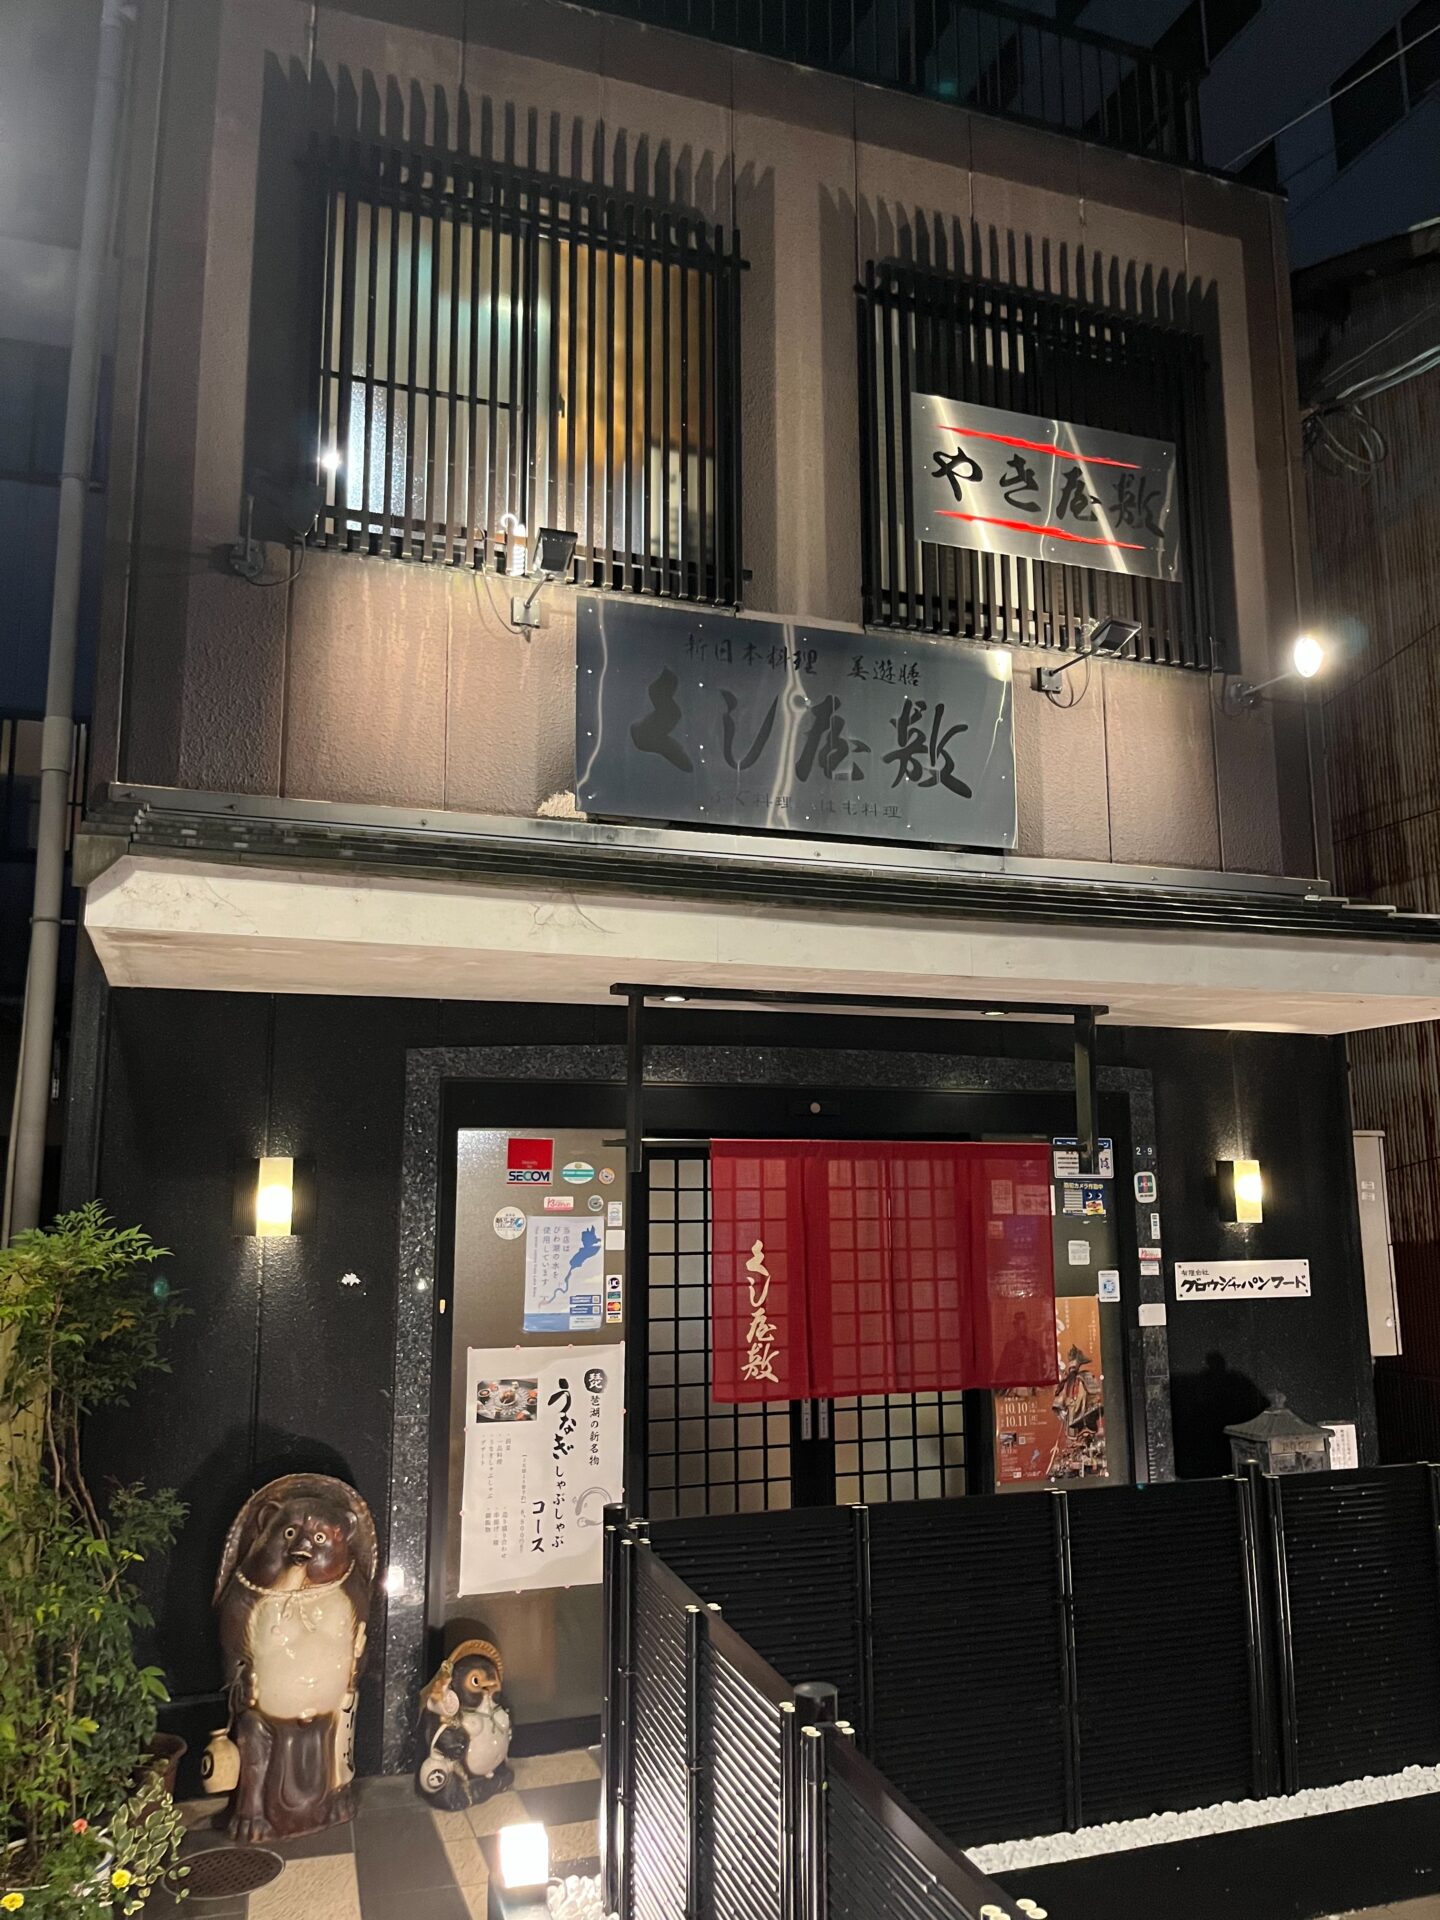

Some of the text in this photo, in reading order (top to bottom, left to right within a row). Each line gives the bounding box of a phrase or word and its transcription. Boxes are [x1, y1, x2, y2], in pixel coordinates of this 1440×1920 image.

[931, 446, 1165, 539] やき屋敷
[686, 633, 818, 676] 新日本料理
[630, 666, 973, 799] くし屋敷
[508, 1170, 551, 1182] SECOM
[740, 1239, 780, 1383] くし屋敷
[1181, 1275, 1307, 1293] グロウジャパンフード
[547, 1378, 577, 1549] うなぎしゃぶしゃぶ
[531, 1499, 546, 1553] コース
